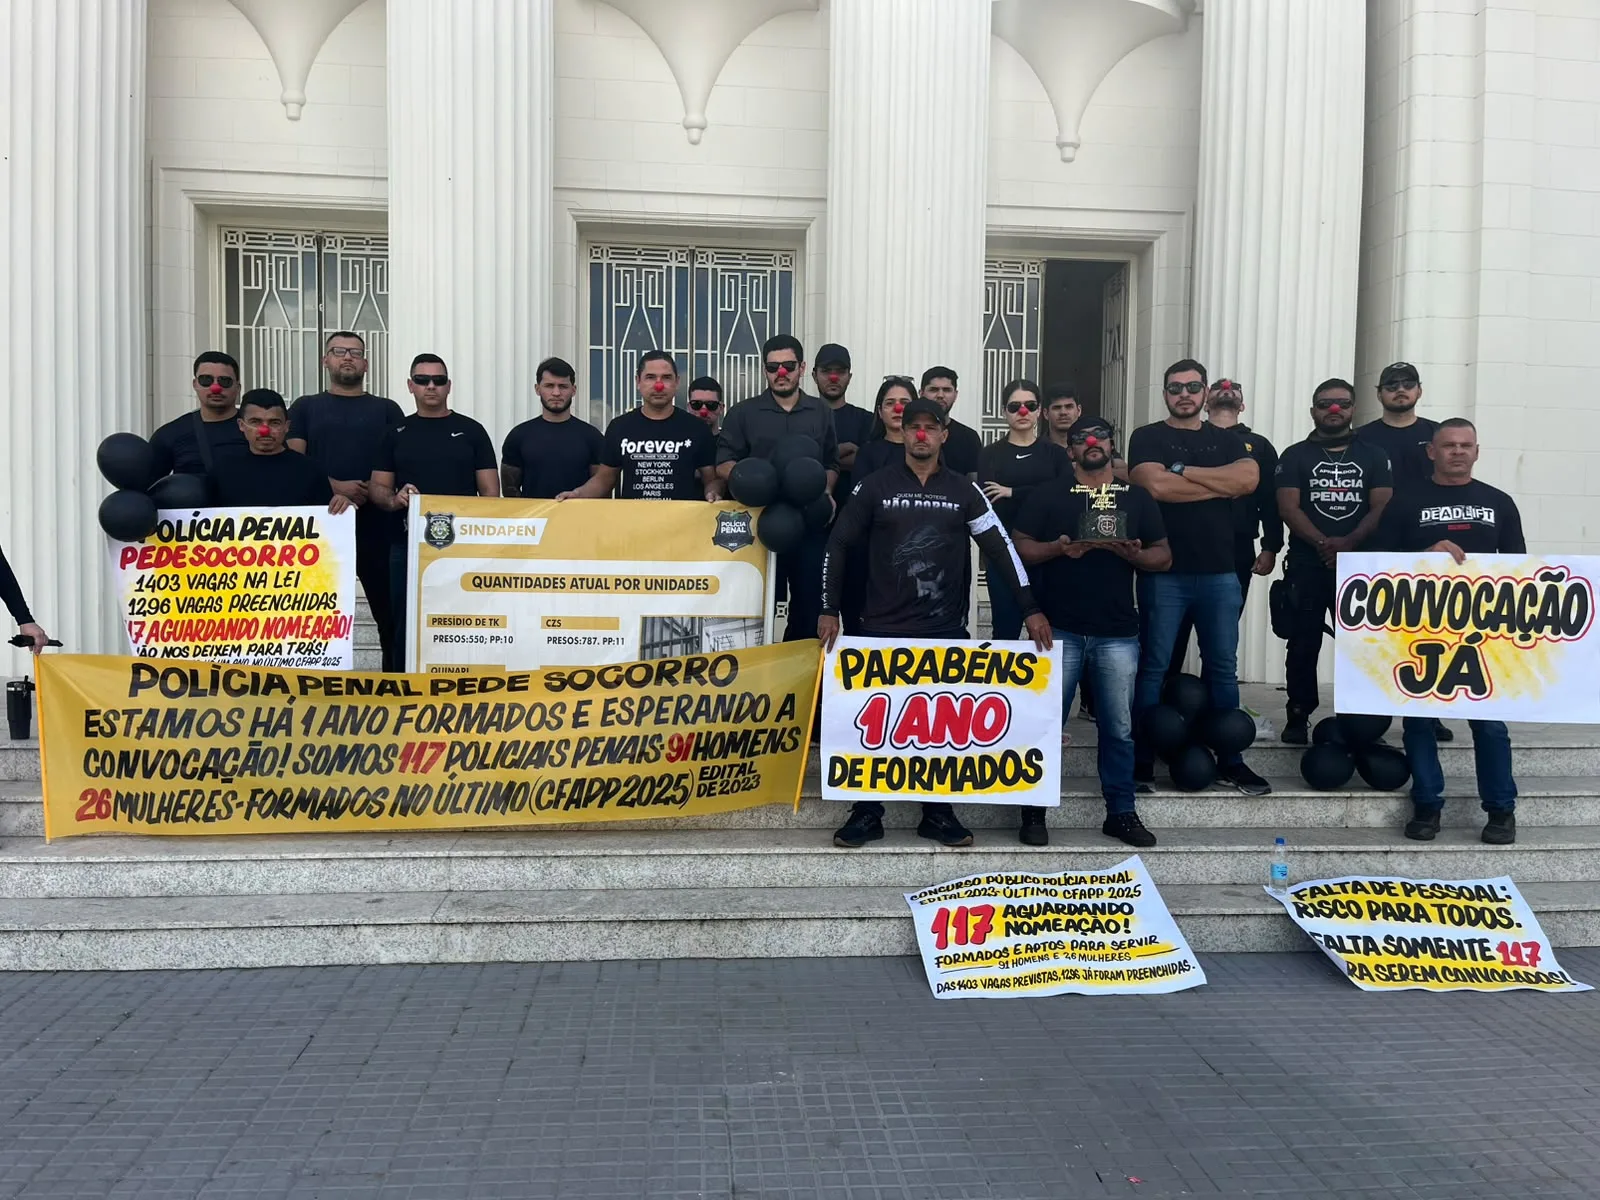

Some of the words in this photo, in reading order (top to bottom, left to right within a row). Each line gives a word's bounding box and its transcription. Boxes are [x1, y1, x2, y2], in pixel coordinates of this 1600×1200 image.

[1309, 478, 1363, 488] POLÍCIA
[882, 497, 910, 509] NÃO
[1310, 491, 1363, 502] PENAL
[1420, 505, 1496, 523] DEADLIFT
[140, 511, 235, 543] OLÍCIA
[238, 515, 320, 541] PENAL
[459, 523, 537, 537] SINDAPEN
[721, 526, 746, 534] PENAL
[120, 544, 187, 570] PEDE
[190, 543, 320, 567] SOCORRO
[135, 573, 181, 593] 1403
[187, 572, 238, 591] VAGAS
[243, 571, 268, 589] NA
[274, 570, 301, 589] LEI
[471, 575, 566, 590] QUANTIDADES
[569, 576, 610, 590] ATUAL
[614, 577, 640, 591] POR
[644, 577, 710, 591] UNIDADES
[128, 597, 171, 617] 1296
[175, 595, 223, 614] VAGAS
[227, 592, 338, 612] PREENCHIDAS
[1339, 570, 1589, 642] CONVOCAÇÃO
[124, 619, 146, 644] 17
[145, 617, 259, 645] AGUARDANDO
[260, 609, 353, 641] NOMEAÇÃO!
[432, 616, 472, 627] PRESÍDIO
[472, 618, 487, 626] DE
[489, 618, 500, 626] TK
[546, 619, 562, 628] CZS
[136, 646, 158, 658] ÃO
[160, 645, 190, 659] NOS
[192, 643, 242, 658] DEIXEM
[247, 642, 284, 657] PARA
[286, 638, 329, 656] TRÁS!
[433, 635, 488, 645] PRESOS:550;
[490, 635, 514, 644] PP:10
[602, 637, 625, 646] PP:11
[263, 656, 295, 667] ÚLTIMO
[295, 656, 322, 667] CFAPP
[321, 656, 343, 667] 2025
[840, 641, 1038, 690] PARABÉNS
[1398, 631, 1488, 696] JÁ
[129, 664, 290, 699] POLÍCIA
[298, 674, 423, 697] PENAL
[430, 673, 530, 697] PEDE
[544, 653, 739, 694] SOCORRO
[84, 706, 243, 740] ESTAMOS
[247, 695, 297, 738] HÁ
[300, 705, 317, 737] 1
[317, 704, 390, 737] ANO
[392, 701, 564, 735] FORMADOS
[572, 699, 594, 728] E
[601, 693, 769, 726] ESPERANDO
[774, 692, 796, 723] A
[854, 692, 890, 750] 1
[890, 692, 1011, 750] ANO
[83, 740, 291, 784] CONVOCAÇÃO!
[292, 744, 398, 776] SOMOS
[398, 740, 446, 775] 117
[443, 739, 569, 772] POLICIAIS
[665, 733, 696, 764] 91
[691, 726, 802, 761] HOMENS
[699, 762, 757, 781] EDITAL
[828, 755, 865, 788] DE
[869, 748, 1043, 791] FORMADOS
[75, 788, 112, 822] 26
[389, 780, 433, 817] NO
[433, 772, 532, 816] ÚLTIMO
[696, 783, 717, 798] DE
[716, 775, 760, 797] 2023
[910, 877, 981, 902] CONCURSO
[986, 872, 1040, 885] PÚBLICO
[1042, 873, 1087, 886] POLÍCIA
[1090, 870, 1133, 885] PENAL
[919, 892, 965, 905] EDITAL
[1003, 885, 1058, 898] ÚLTIMO
[1062, 888, 1104, 899] CFAPP
[1107, 884, 1142, 898] 2025
[1290, 881, 1367, 901] FALTA
[1368, 880, 1397, 896] DE
[1398, 882, 1513, 903] PESSOAL:
[1002, 901, 1134, 919] AGUARDANDO
[1294, 899, 1363, 919] RISCO
[1367, 902, 1431, 924] PARA
[1431, 903, 1523, 929] TODOS.
[931, 903, 996, 950] 117
[1003, 915, 1132, 937] NOMEAÇÃO!
[934, 946, 1010, 968] FORMADOS
[1013, 944, 1023, 955] E
[1025, 940, 1066, 954] APTOS
[1070, 939, 1106, 952] PARA
[1111, 935, 1160, 950] SERVIR
[998, 961, 1010, 970] 91
[1012, 954, 1051, 968] HOMENS
[1064, 952, 1077, 960] 26
[1078, 951, 1132, 963] MULHERES
[1383, 934, 1496, 962] SOMENTE
[1496, 941, 1541, 967] 117
[937, 981, 957, 994] DAS
[957, 979, 979, 992] 1403
[981, 976, 1011, 990] VAGAS
[1083, 966, 1094, 981] JÁ
[1094, 968, 1126, 982] FORAM
[1126, 962, 1196, 981] PREENCHIDAS.
[1376, 963, 1444, 982] SEREM
[1444, 966, 1577, 986] CONVOCADOS!
